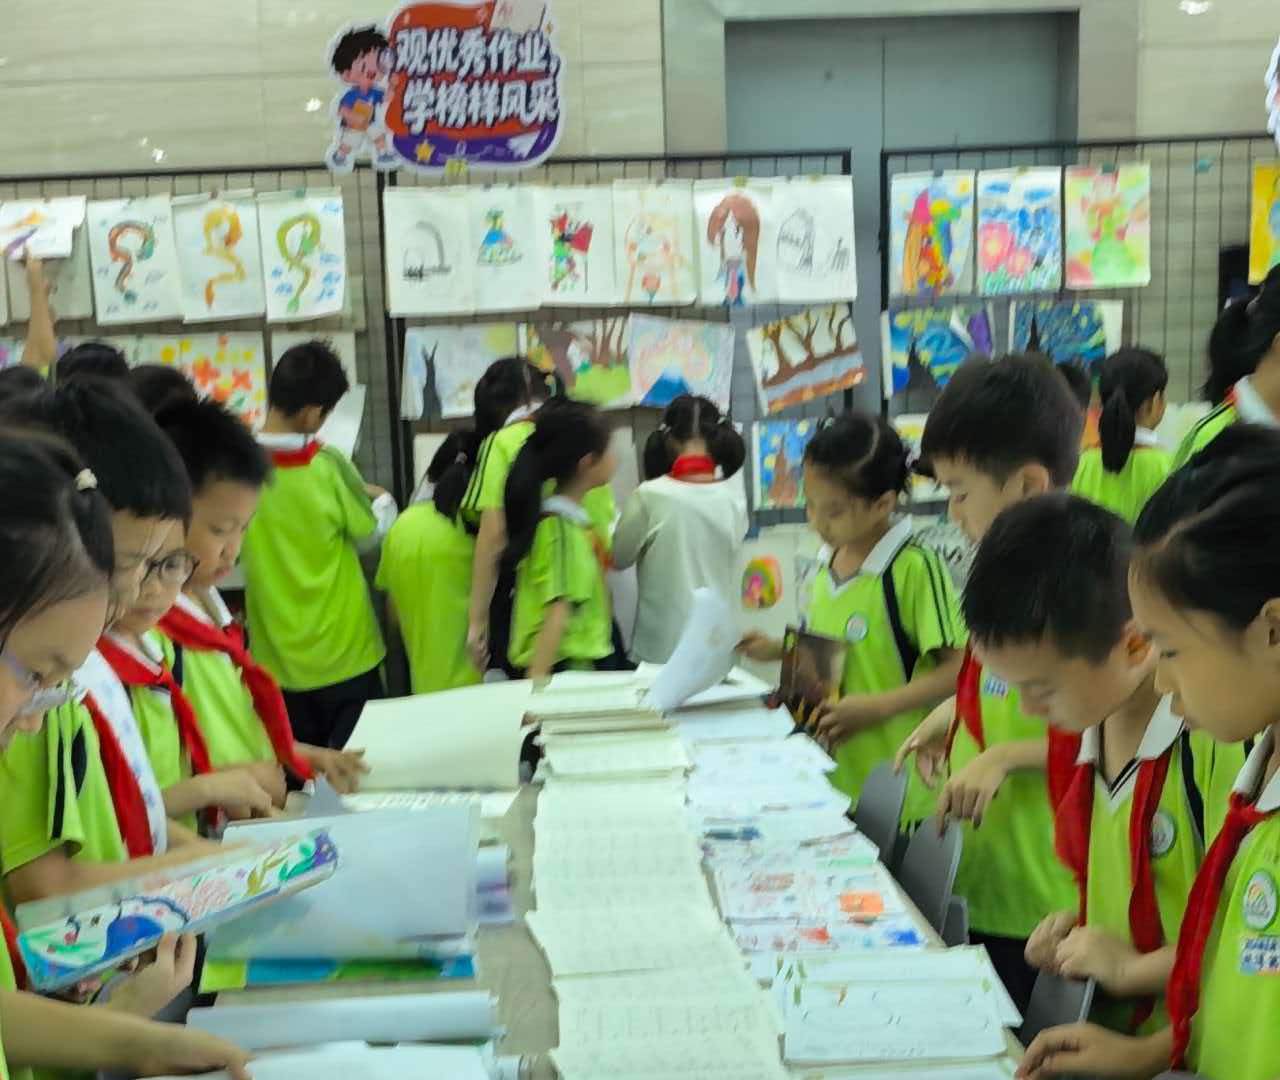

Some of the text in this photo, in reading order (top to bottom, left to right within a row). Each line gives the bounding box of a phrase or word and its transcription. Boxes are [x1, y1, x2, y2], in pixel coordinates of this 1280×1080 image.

[402, 77, 560, 135] 学榜样风采
